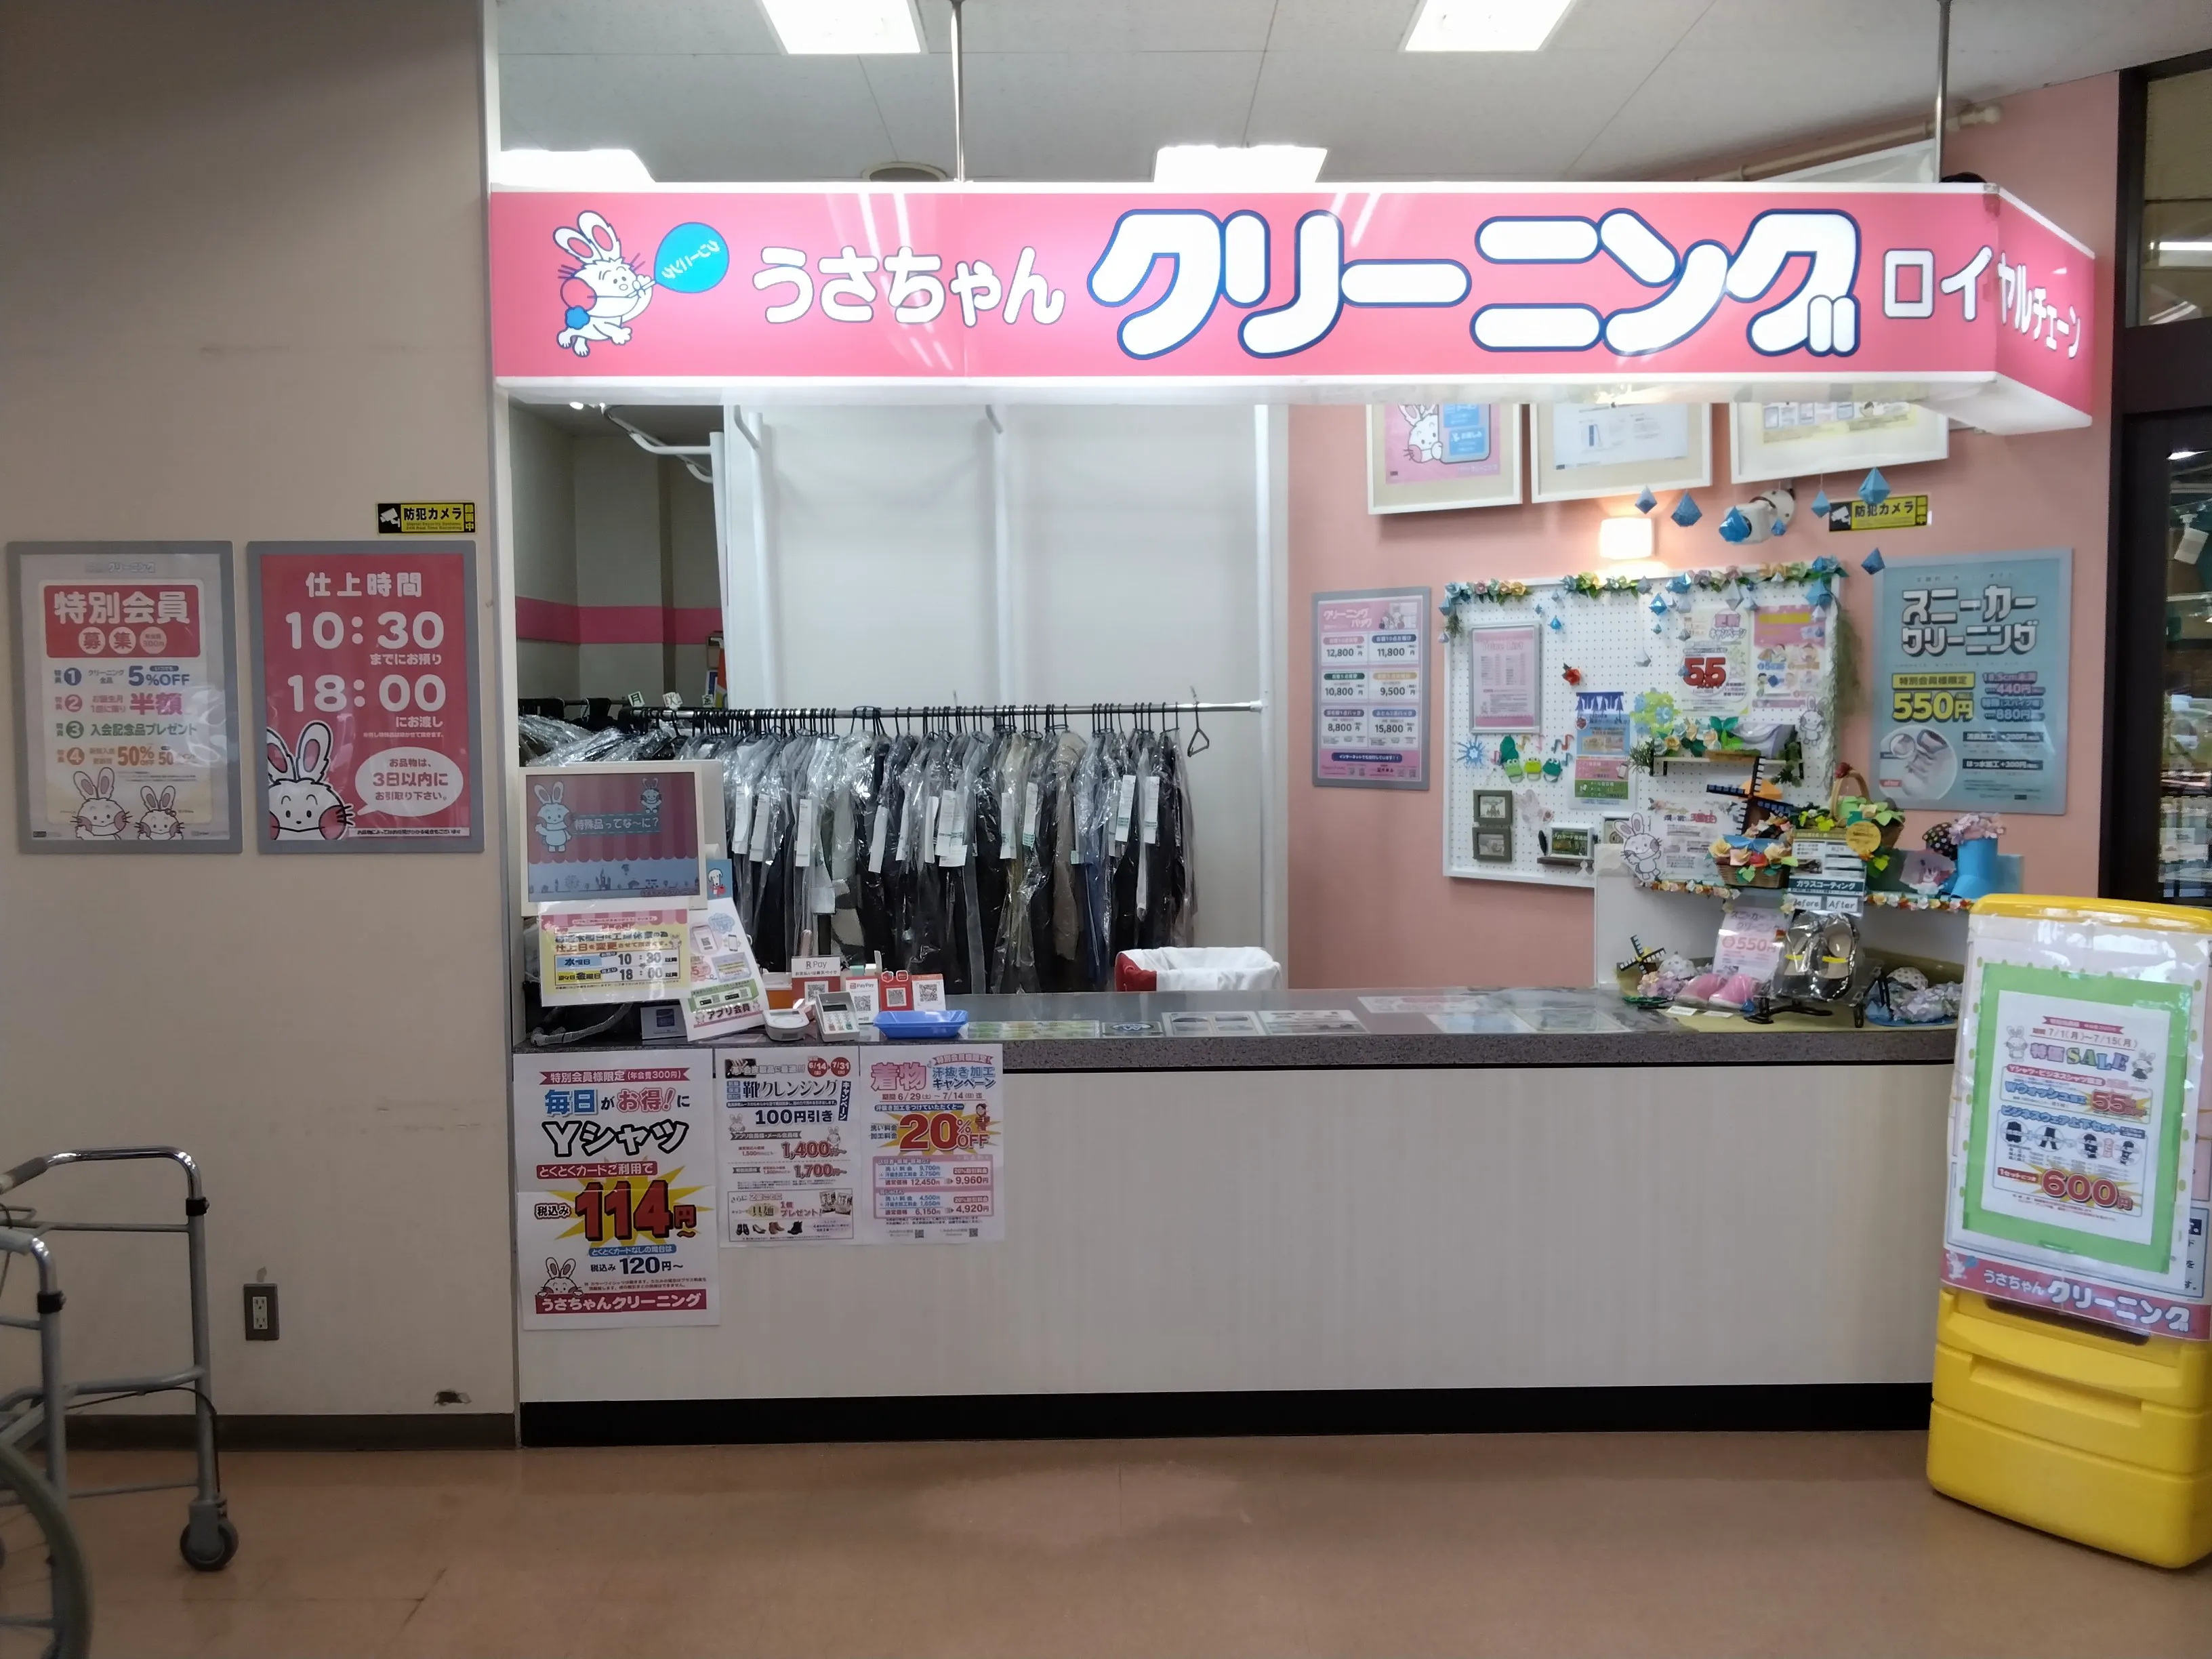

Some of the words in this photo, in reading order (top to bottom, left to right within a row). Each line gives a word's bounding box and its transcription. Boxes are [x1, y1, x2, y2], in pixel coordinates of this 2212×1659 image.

[752, 245, 1065, 327] うさちゃん
[1086, 209, 1862, 360] クリーニング
[404, 508, 462, 520] 防犯カメラ
[1855, 501, 1914, 518] 防犯カメラ
[306, 572, 422, 598] 仕上時間
[54, 591, 190, 624] 特別会員
[1902, 584, 2038, 624] スニーカー
[1324, 608, 1370, 620] クリーニング
[285, 611, 444, 649] 10:30
[83, 632, 132, 649] 募集
[1902, 620, 2039, 657] クリーニング
[369, 653, 442, 665] までにお預り
[1326, 649, 1354, 657] 12,800
[1377, 648, 1405, 657] 11,800
[1899, 675, 1967, 686] 特別会員様限定
[287, 674, 446, 712] 18:00
[1325, 687, 1354, 697] 10,800
[1380, 687, 1406, 697] 9,500
[1996, 683, 2031, 695] 440円
[129, 693, 183, 715] 半額
[630, 693, 642, 706] 月
[1893, 691, 1974, 722] 550円
[90, 722, 197, 737] 入会記念品プレゼント
[396, 716, 443, 728] にお渡し
[1328, 724, 1352, 733] 8,800
[1375, 724, 1404, 734] 15,800
[389, 758, 432, 768] お品物は、
[373, 772, 449, 787] 3日以内に
[375, 792, 447, 801] お引取り下さい。
[1797, 881, 1856, 890] ガラスコーティング
[1828, 899, 1856, 909] After
[1736, 936, 1777, 953] 550円
[813, 960, 827, 968] Pay
[707, 1004, 751, 1020] アプリ会員
[808, 1062, 827, 1071] 6/14
[933, 1066, 996, 1079] 汗抜き加工
[550, 1071, 625, 1083] 特別会員様限定
[871, 1061, 926, 1092] 着物
[933, 1078, 996, 1090] キャンペーン
[743, 1080, 838, 1099] 靴クレンジング
[840, 1082, 851, 1120] キャンペーン
[755, 1109, 834, 1125] 100円引き
[541, 1119, 689, 1158] Yシャツ
[539, 1162, 655, 1178] とくとくカードご利用で
[956, 1176, 989, 1185] 9,960円
[2041, 1168, 2133, 1211] 600円
[535, 1203, 571, 1219] 税込み
[956, 1204, 989, 1213] 4,920円
[591, 1246, 673, 1256] とくとくカードなしの場合は
[590, 1263, 617, 1273] 税込み
[1984, 1269, 2045, 1296] うさちゃん
[542, 1292, 702, 1312] うさちゃんクリーニング
[2047, 1279, 2192, 1332] クリーニング
